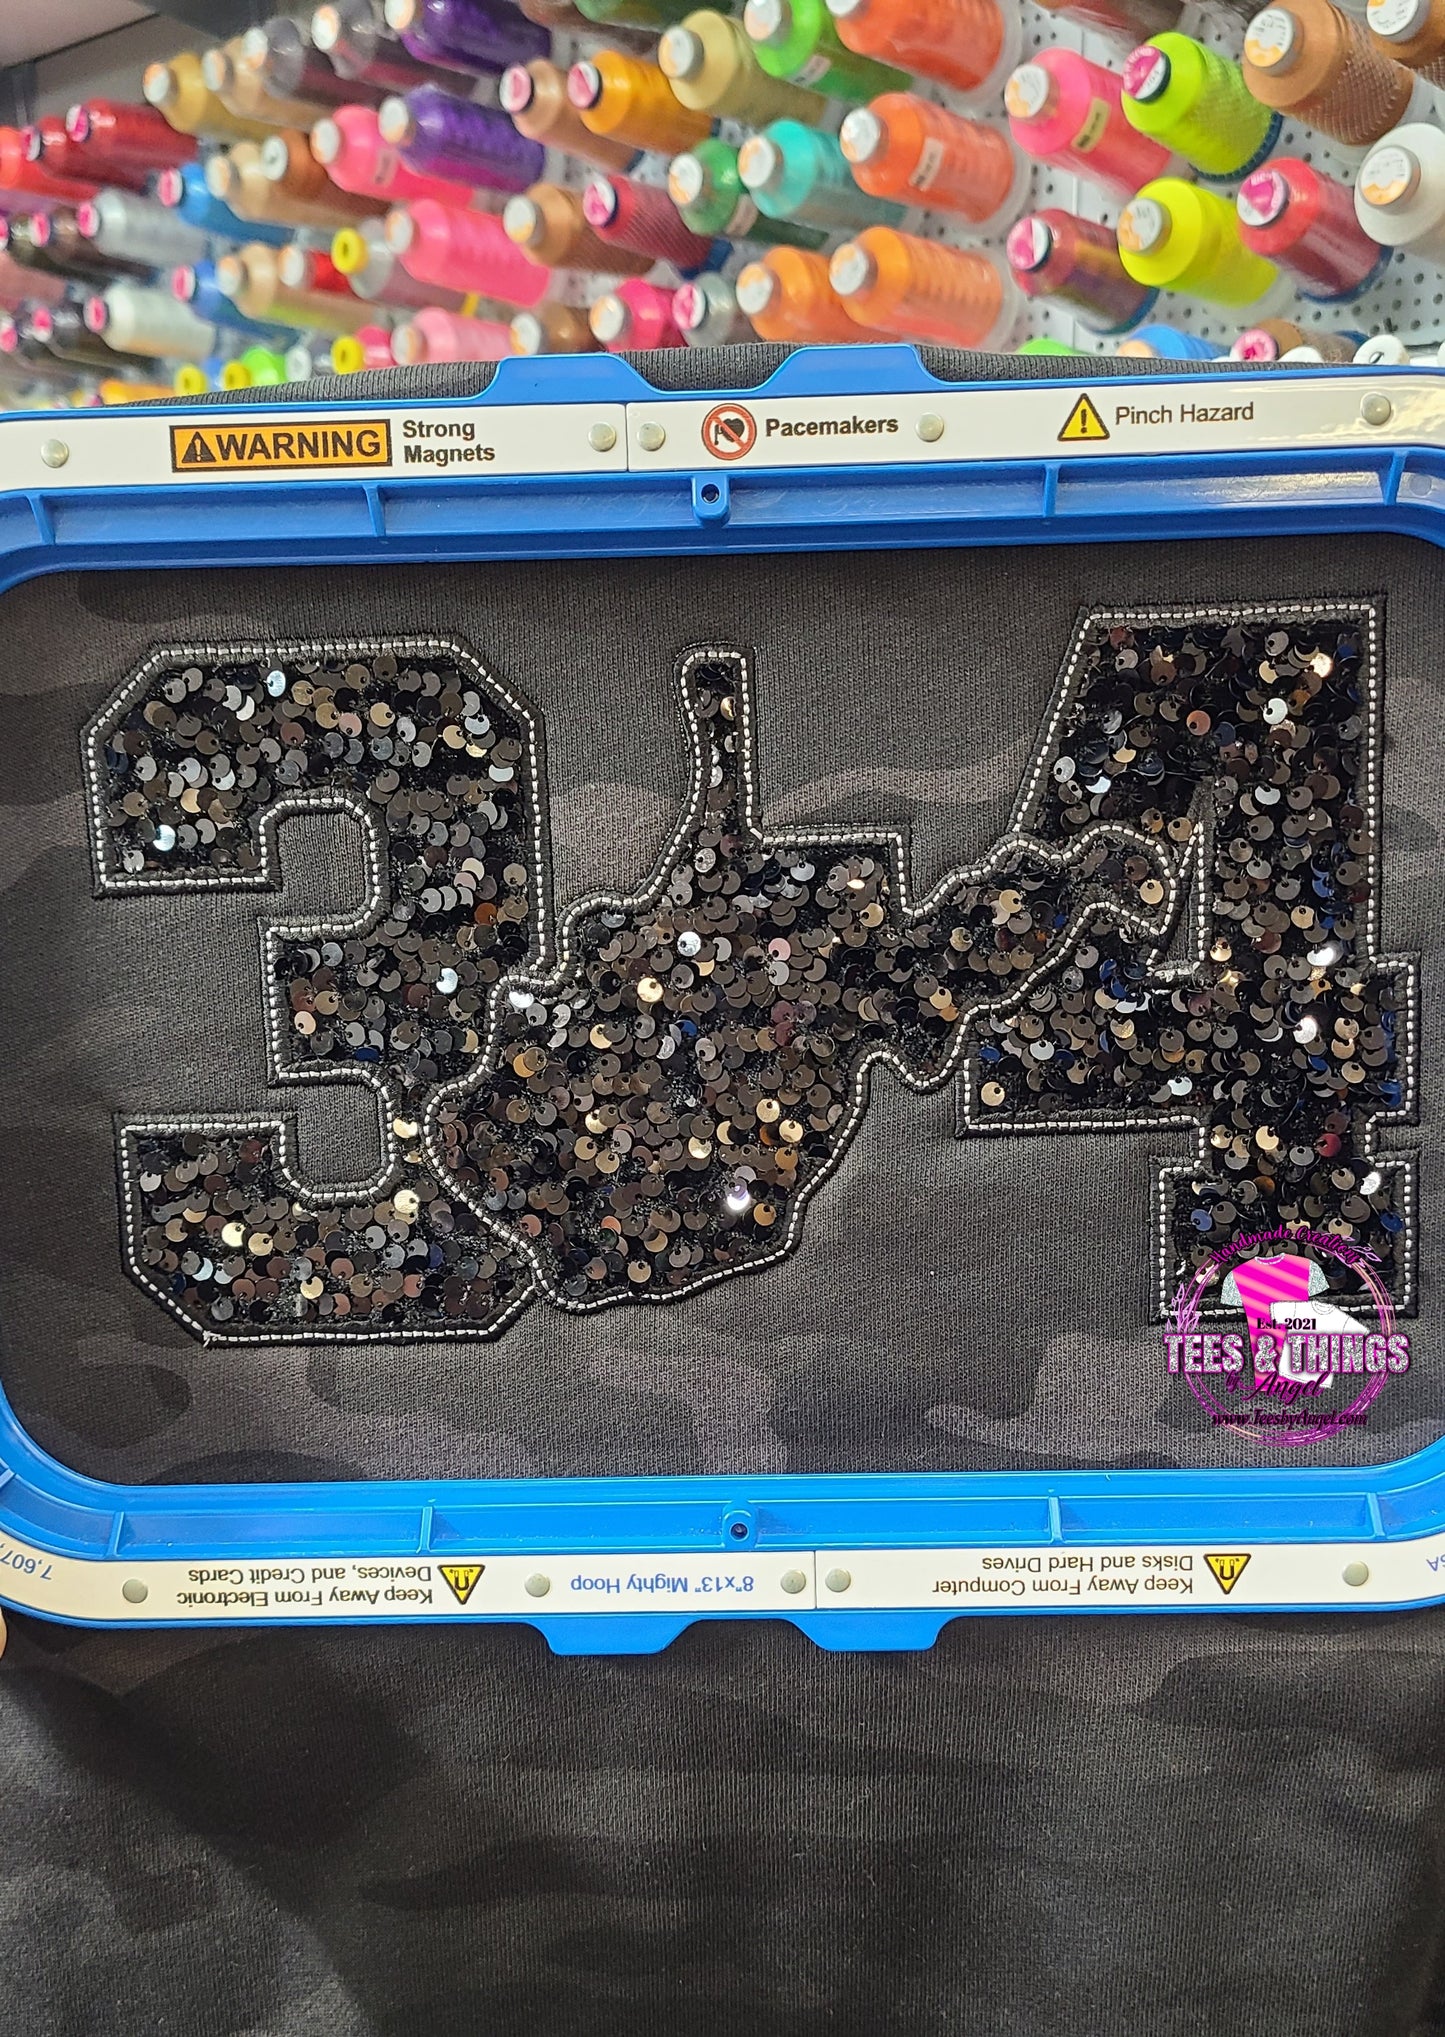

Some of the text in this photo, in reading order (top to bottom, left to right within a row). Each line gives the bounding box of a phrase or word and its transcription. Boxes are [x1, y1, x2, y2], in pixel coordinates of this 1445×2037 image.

[1115, 401, 1254, 426] Pinch Hazard
[402, 419, 475, 442] Strong
[765, 415, 899, 437] Pacemakers
[214, 428, 381, 463] WARNING
[403, 443, 496, 468] Magnets
[188, 1565, 432, 1585] Devices, and Credit Cards
[982, 1555, 1193, 1573] Disks and Hard Drives
[570, 1574, 621, 1594] Hoop
[626, 1573, 688, 1594] Mighty
[932, 1575, 1193, 1596] Keep Away From Computer
[176, 1586, 433, 1608] Keep Away From Electronic
